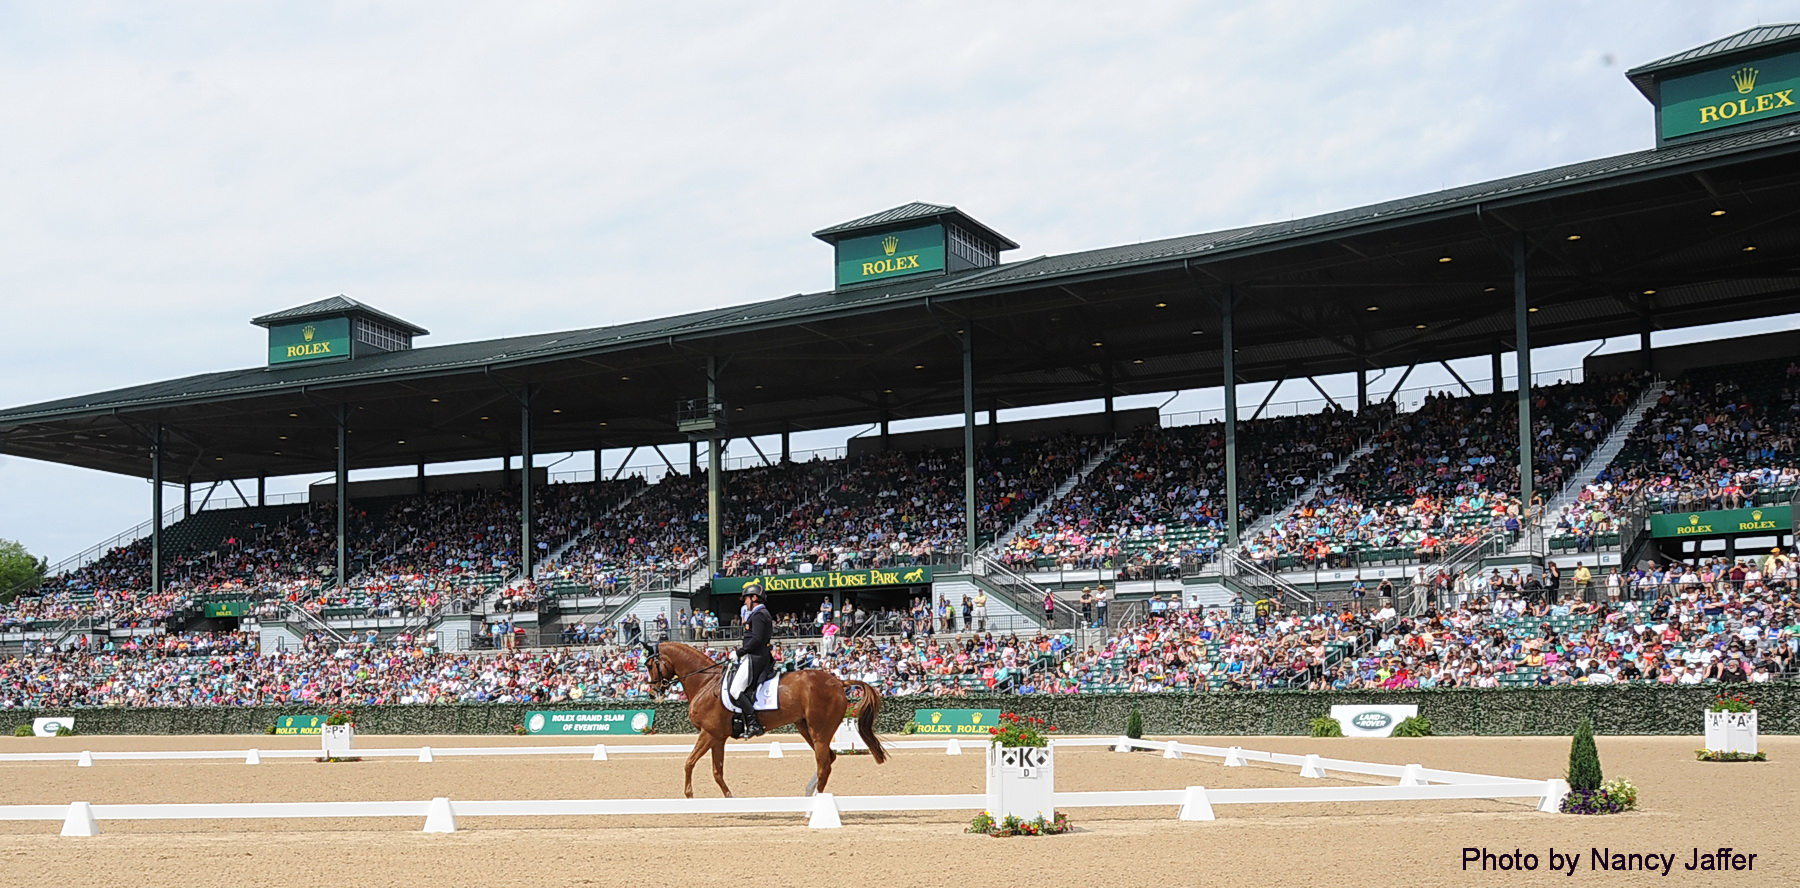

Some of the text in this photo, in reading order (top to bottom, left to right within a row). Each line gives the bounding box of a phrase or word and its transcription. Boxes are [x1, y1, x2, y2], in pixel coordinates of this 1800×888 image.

[1699, 89, 1795, 124] ROLEX
[862, 254, 919, 276] ROLEX
[287, 341, 331, 357] ROLEX
[1677, 525, 1712, 535] ROLEX
[1739, 521, 1776, 530] ROLEX
[764, 569, 899, 591] KENTUCKY HORSE PARK
[552, 714, 625, 722] ROLEX GRAND SLAM
[1713, 714, 1719, 727] A
[1737, 715, 1746, 727] A
[332, 726, 338, 734] P
[562, 723, 610, 731] OF EVENTING
[917, 725, 951, 733] ROLEX
[1019, 748, 1035, 767] K
[1023, 768, 1030, 777] D
